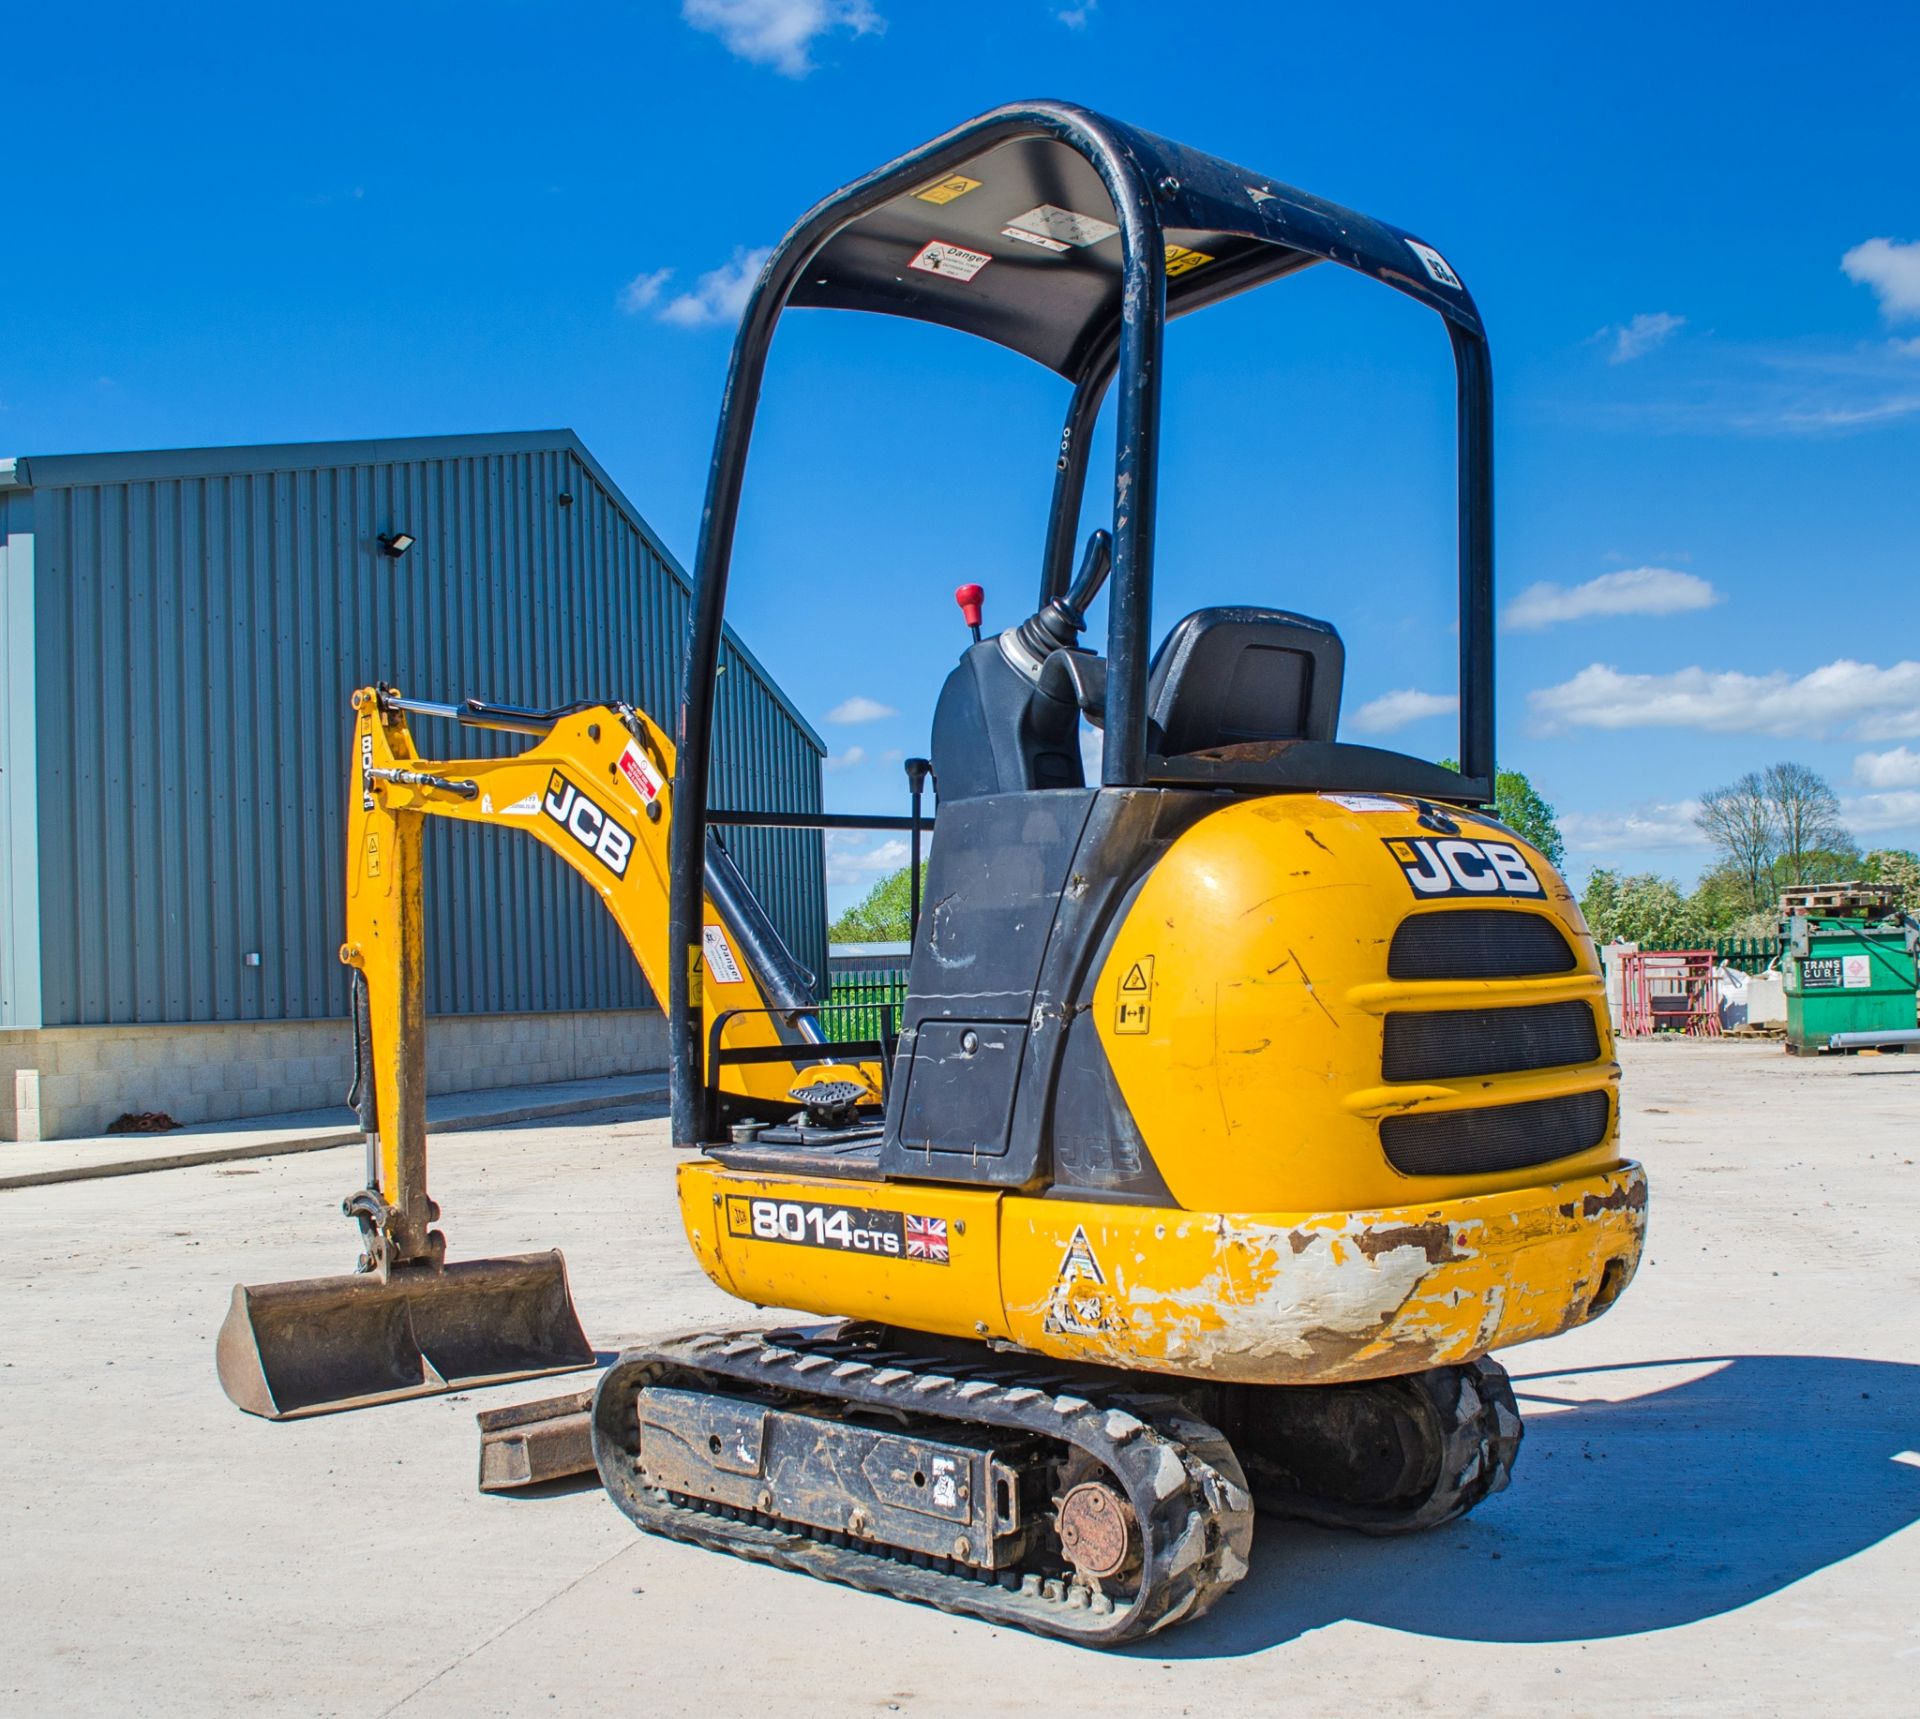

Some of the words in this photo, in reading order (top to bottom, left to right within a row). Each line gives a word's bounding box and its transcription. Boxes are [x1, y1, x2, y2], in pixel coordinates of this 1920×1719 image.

[947, 247, 986, 265] Danger
[545, 784, 631, 873] JCB
[1405, 841, 1540, 893] JCB
[720, 944, 741, 980] Danger
[1803, 960, 1841, 970] TRANS
[1803, 969, 1841, 979] CUBE
[1058, 1135, 1142, 1174] JCB
